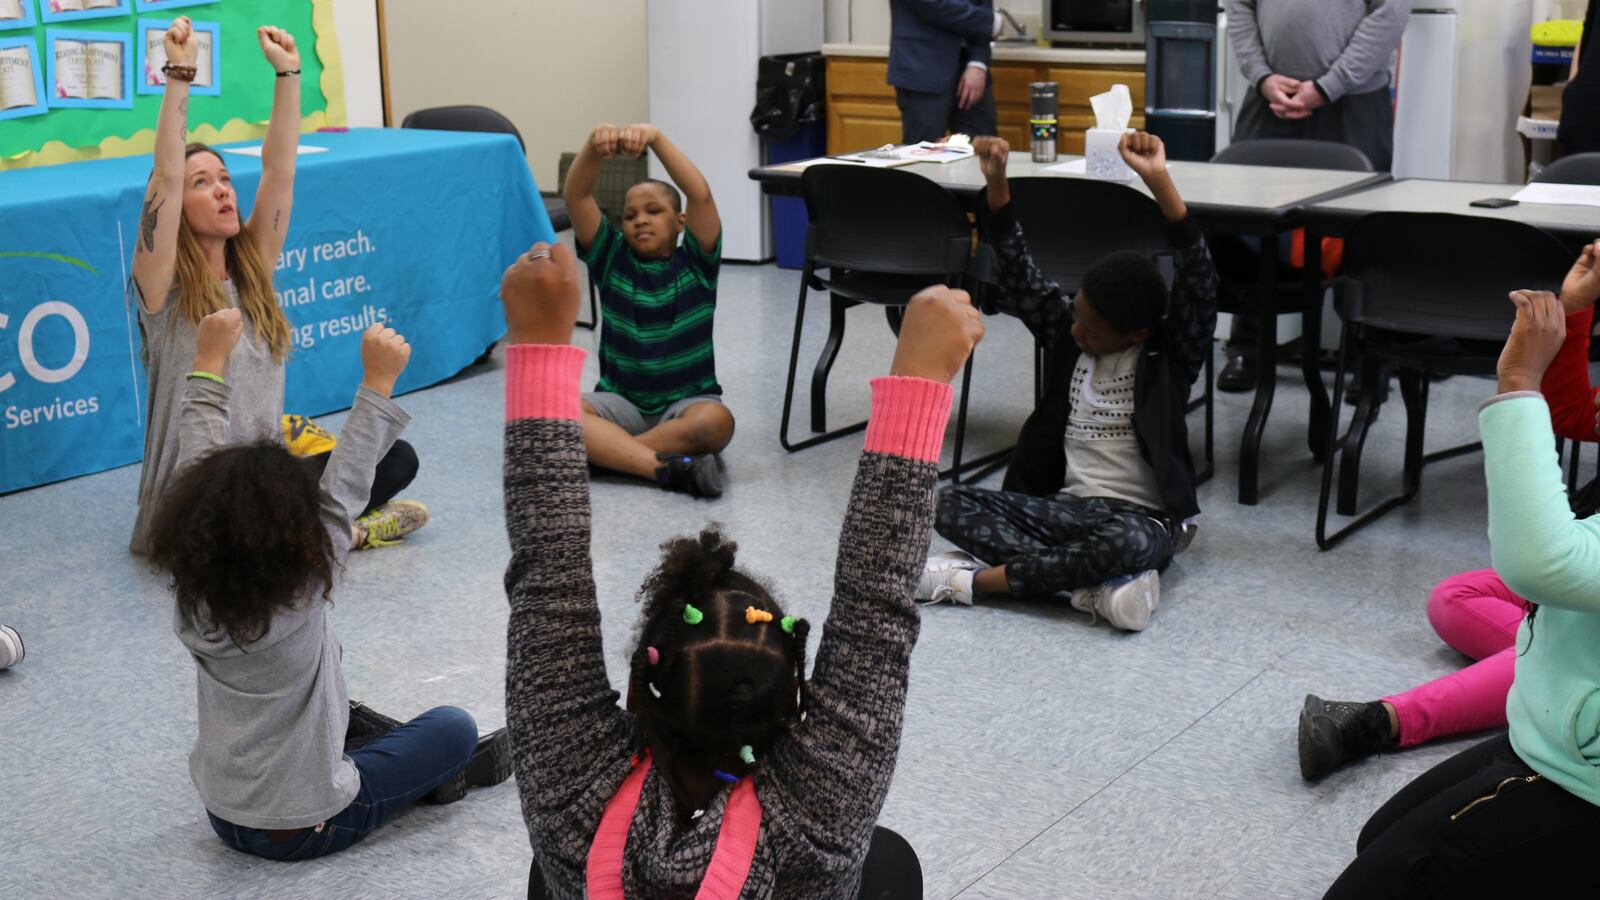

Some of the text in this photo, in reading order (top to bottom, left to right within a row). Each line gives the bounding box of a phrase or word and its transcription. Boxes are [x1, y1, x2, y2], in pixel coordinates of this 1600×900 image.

[313, 229, 376, 263] reach.
[321, 275, 372, 300] care.
[319, 304, 393, 340] results.
[5, 396, 99, 429] Services
